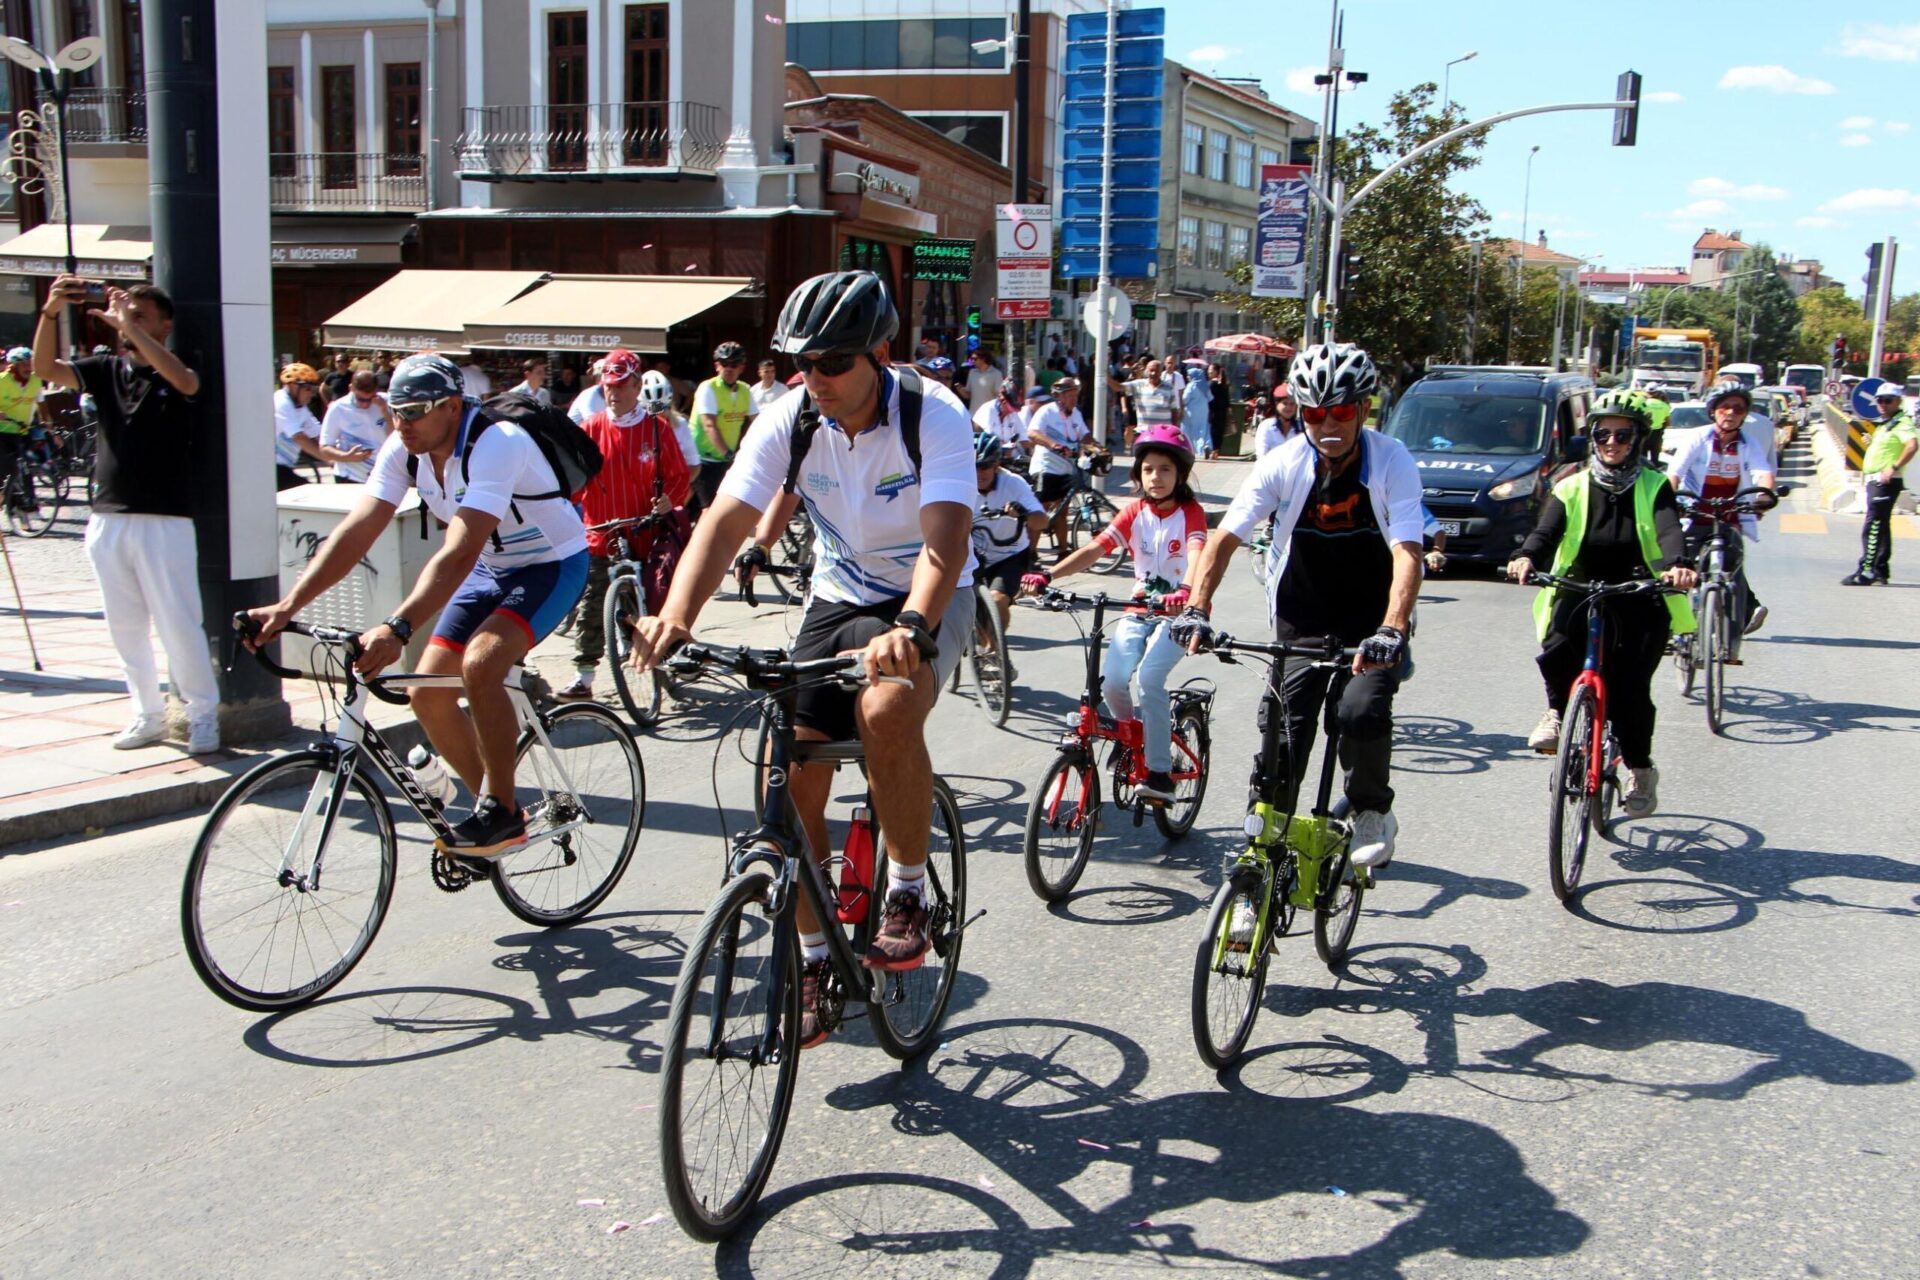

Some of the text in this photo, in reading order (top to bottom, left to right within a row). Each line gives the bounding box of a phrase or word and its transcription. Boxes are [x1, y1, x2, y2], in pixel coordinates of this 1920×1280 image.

[290, 247, 358, 260] MÜCEVHERAT
[914, 245, 970, 258] CHANGE
[354, 334, 406, 347] ARMAĞAN
[505, 333, 621, 347] COFFEE SHOT STOP
[1416, 461, 1495, 473] ABITA
[376, 749, 445, 824] SCOTT
